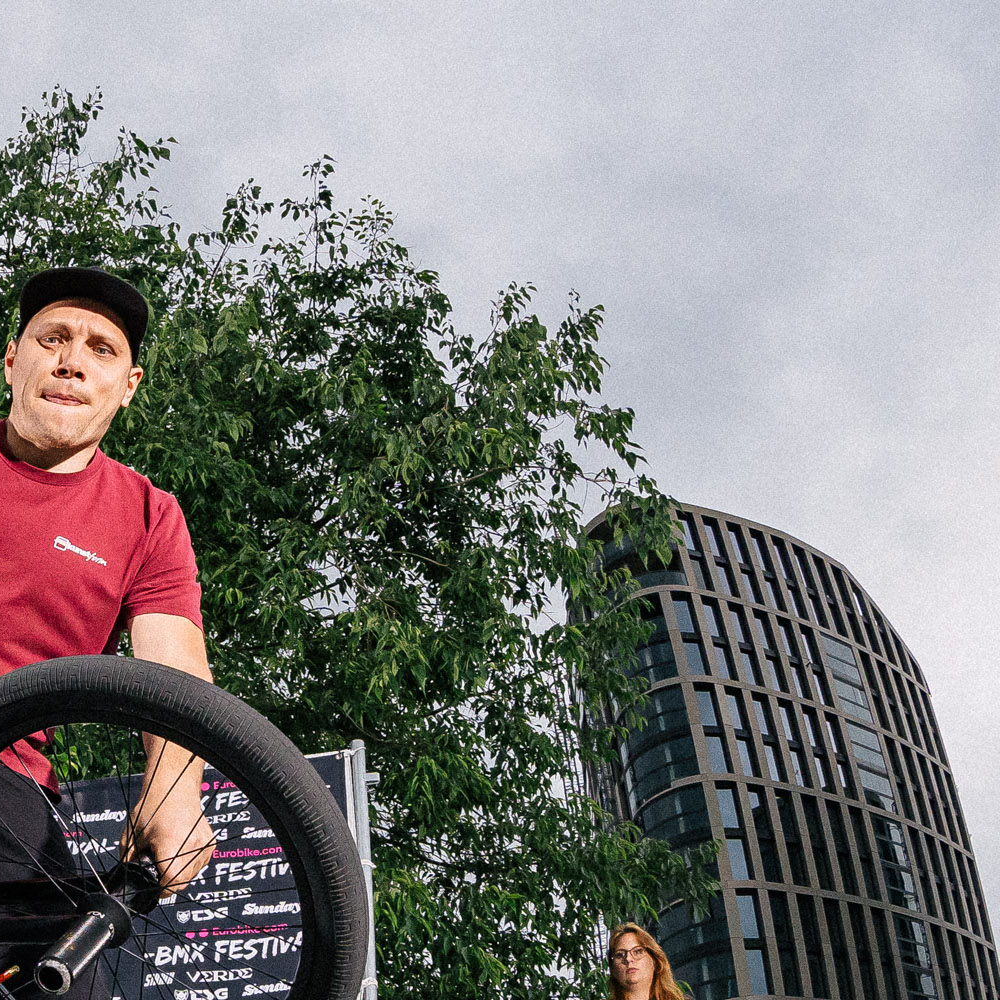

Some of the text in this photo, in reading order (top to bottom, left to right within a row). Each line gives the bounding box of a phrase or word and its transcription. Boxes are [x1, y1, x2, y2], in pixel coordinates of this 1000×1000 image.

[205, 810, 251, 825] ERDE
[241, 827, 276, 839] Sun
[242, 901, 301, 916] Sunday
[242, 980, 293, 997] Sunda
